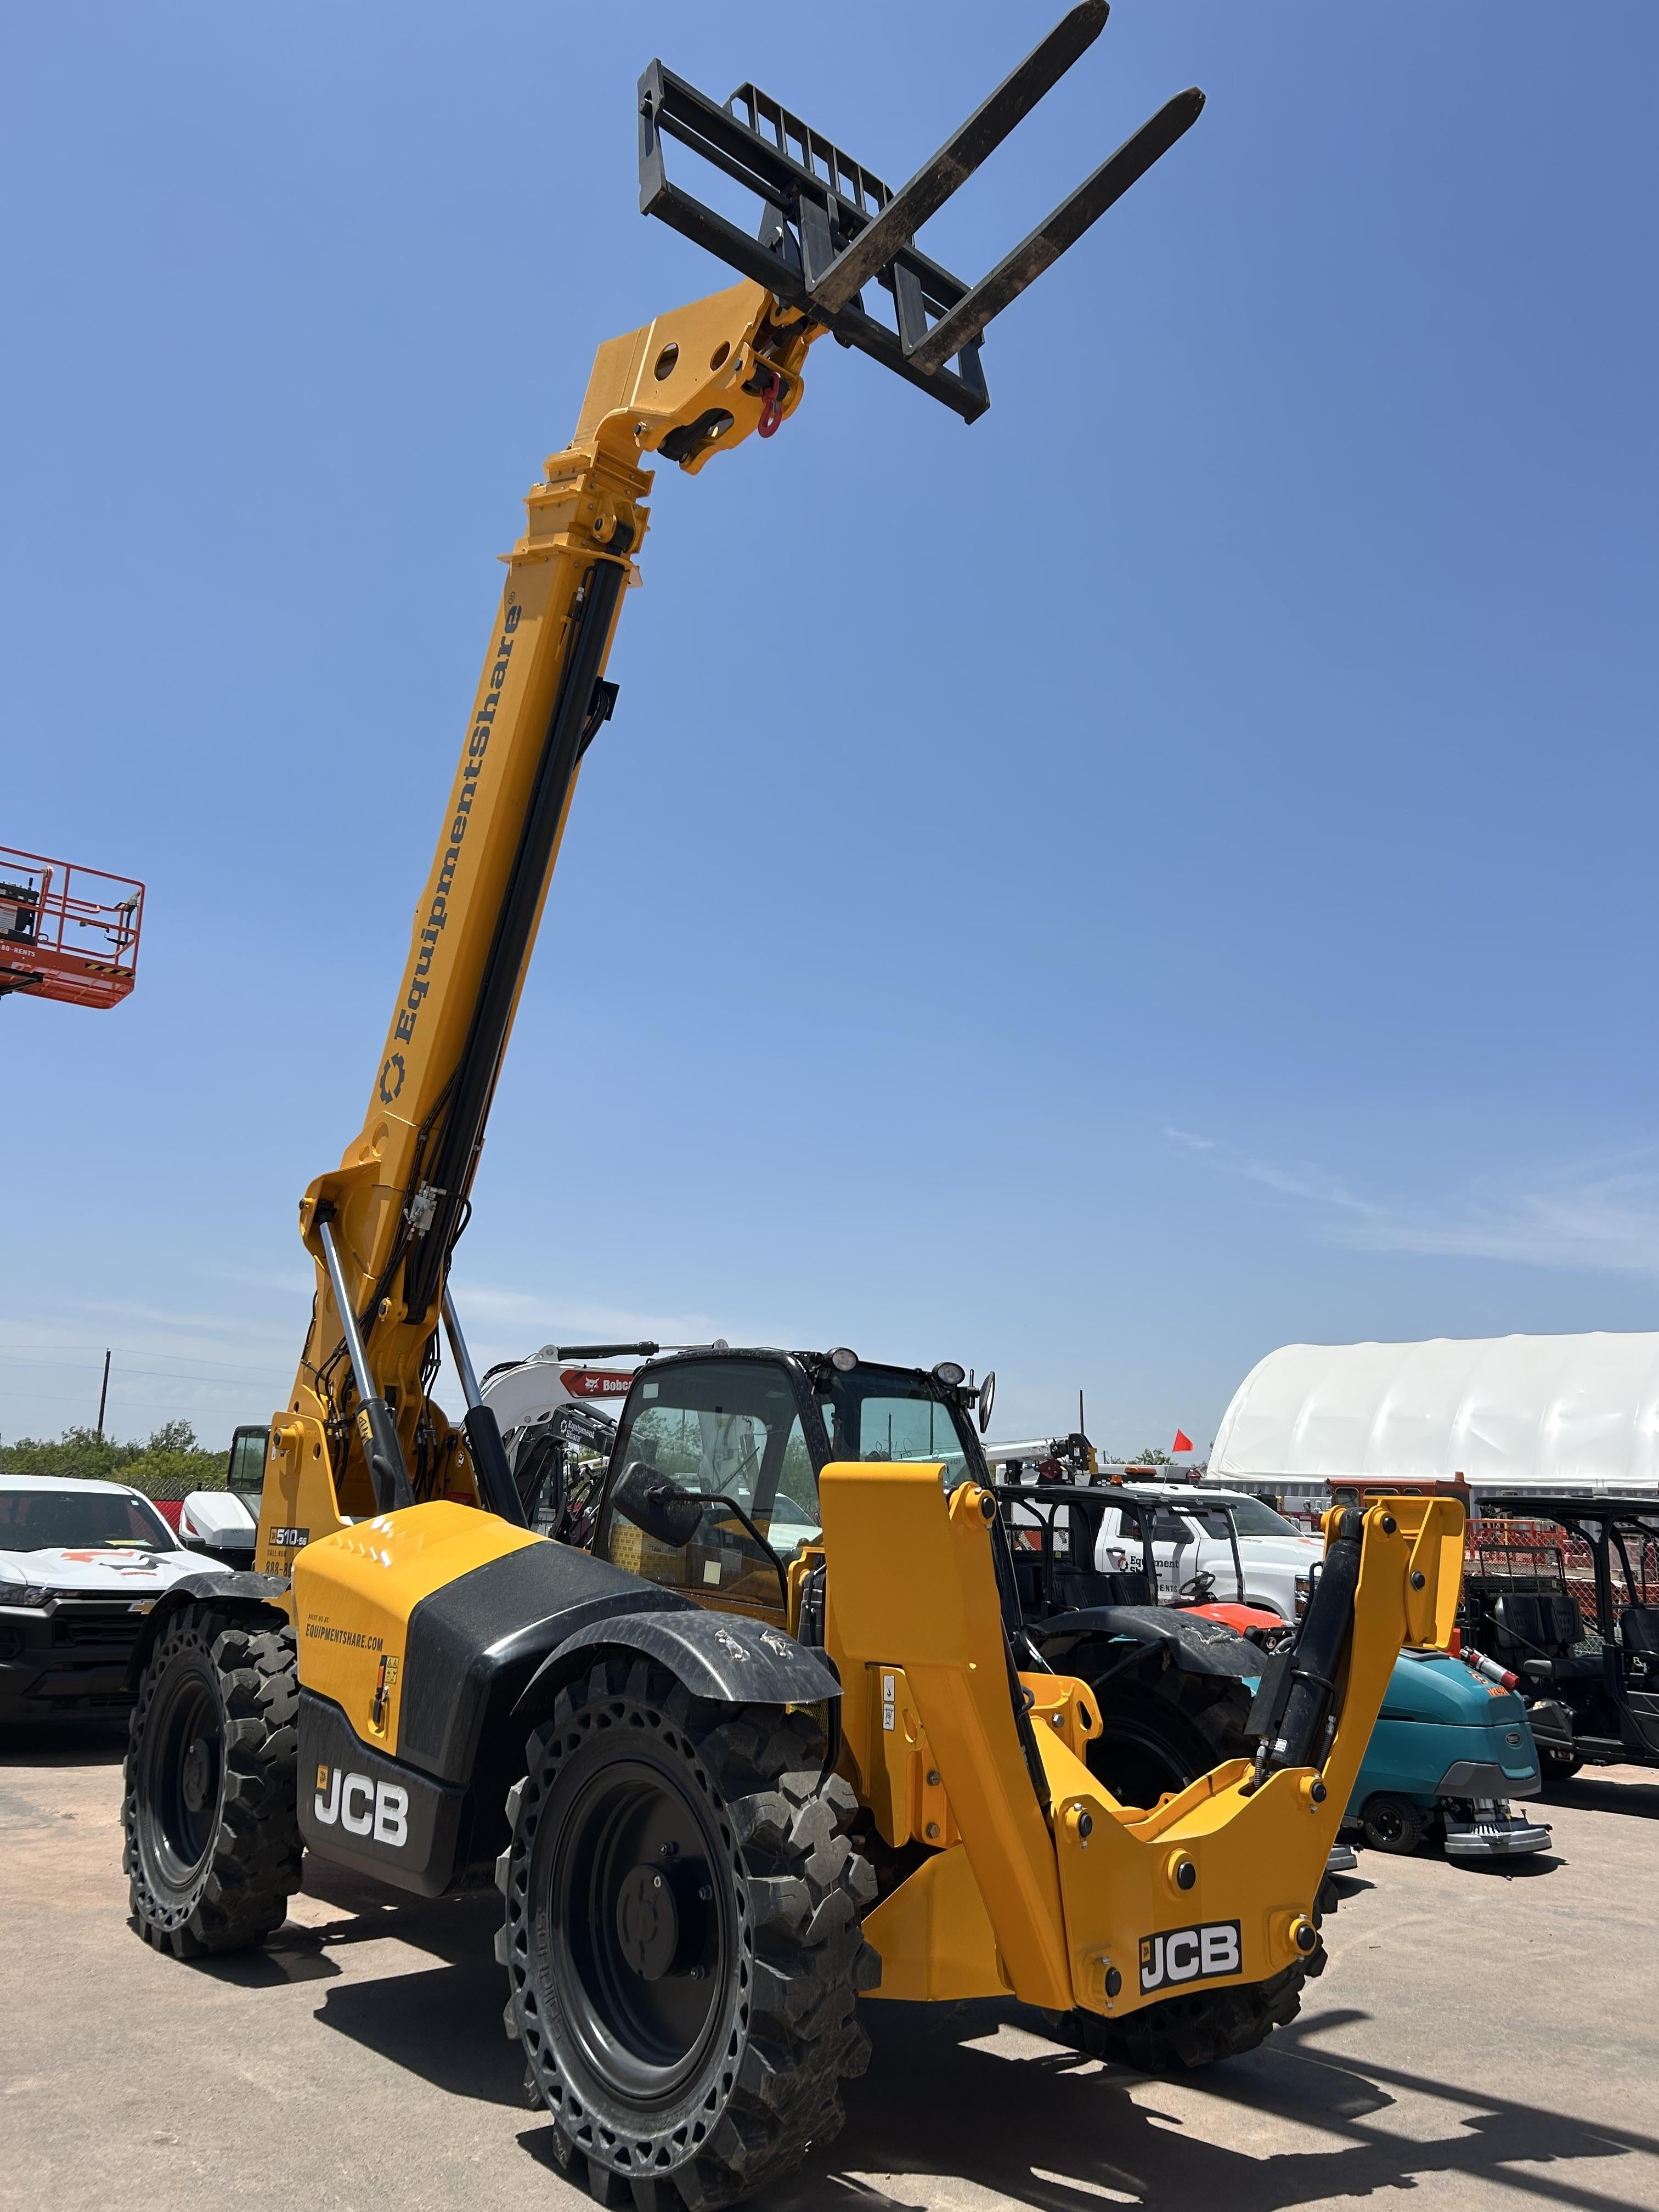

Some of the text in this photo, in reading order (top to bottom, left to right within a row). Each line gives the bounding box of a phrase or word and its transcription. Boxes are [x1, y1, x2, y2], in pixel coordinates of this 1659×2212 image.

[394, 605, 522, 1045] EquipmentShare
[0, 944, 36, 957] 80-RENTS
[567, 1419, 595, 1439] Equipment
[305, 1623, 383, 1652] EQUIPMENTSHARE.COM
[314, 1768, 409, 1847] JCB
[1142, 1925, 1239, 1989] JCB
